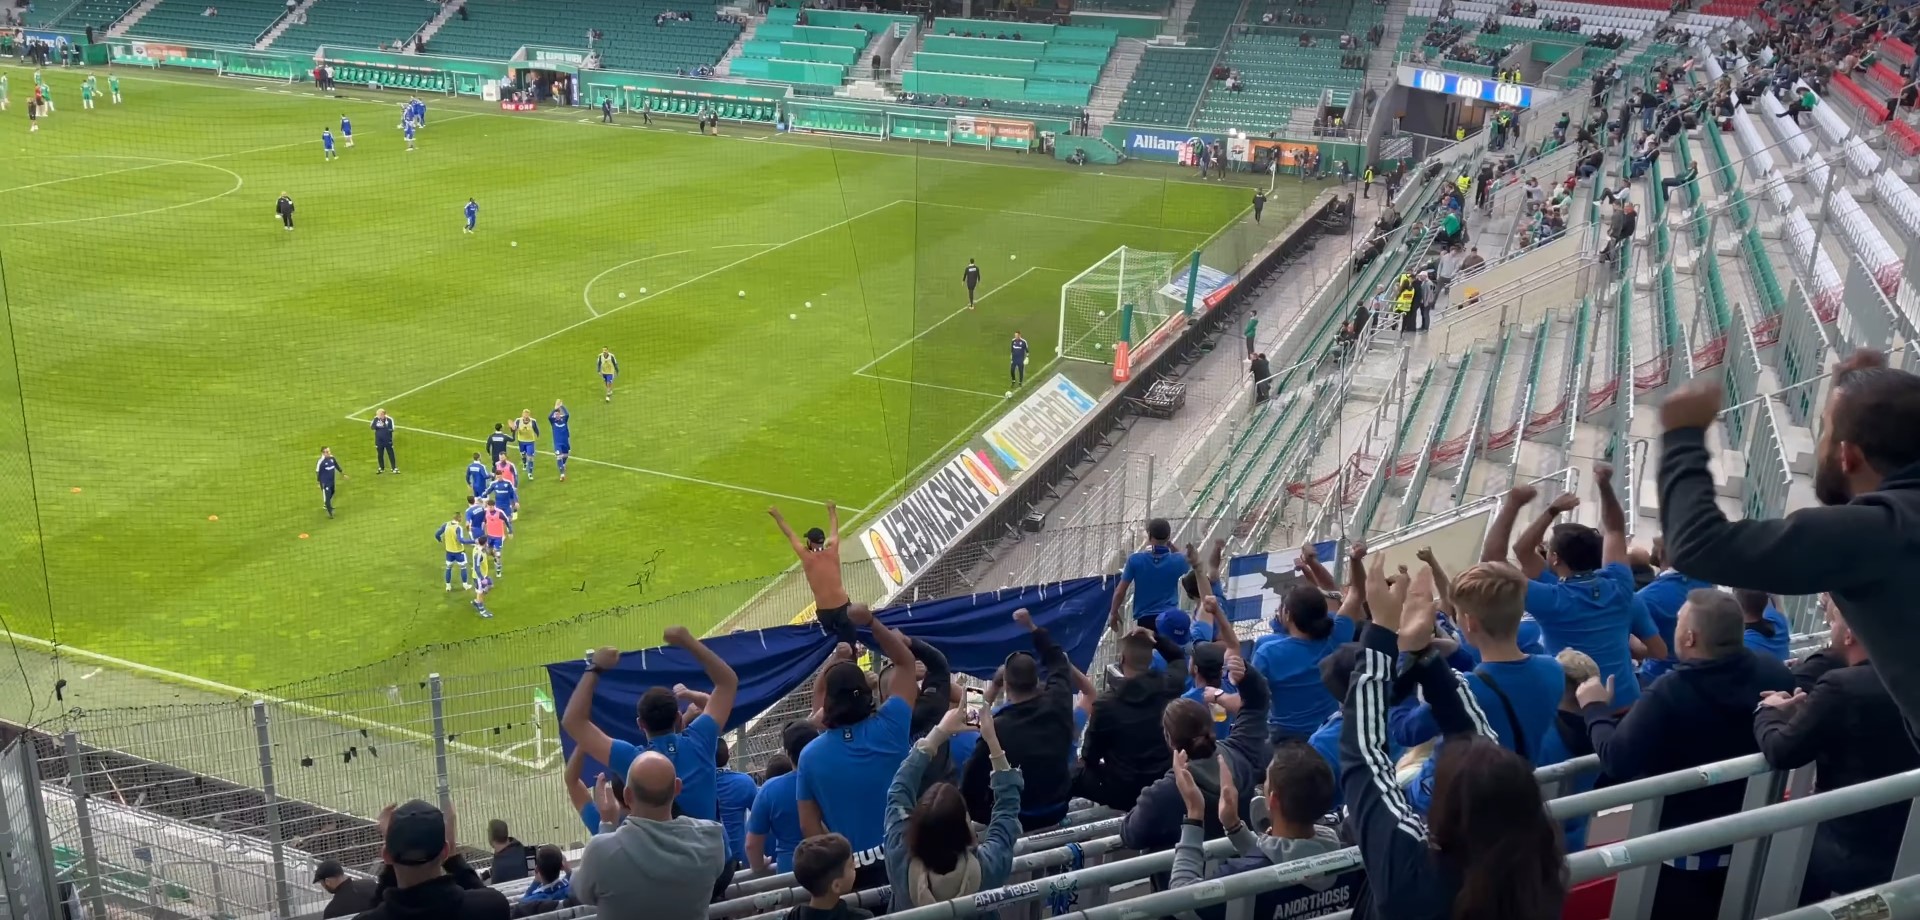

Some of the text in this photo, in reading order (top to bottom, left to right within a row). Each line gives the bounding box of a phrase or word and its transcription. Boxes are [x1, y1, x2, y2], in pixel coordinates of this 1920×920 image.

[1133, 134, 1182, 151] Allianz
[881, 460, 990, 575] FORSTINGER
[1272, 885, 1350, 920] ANORTHOSIS
